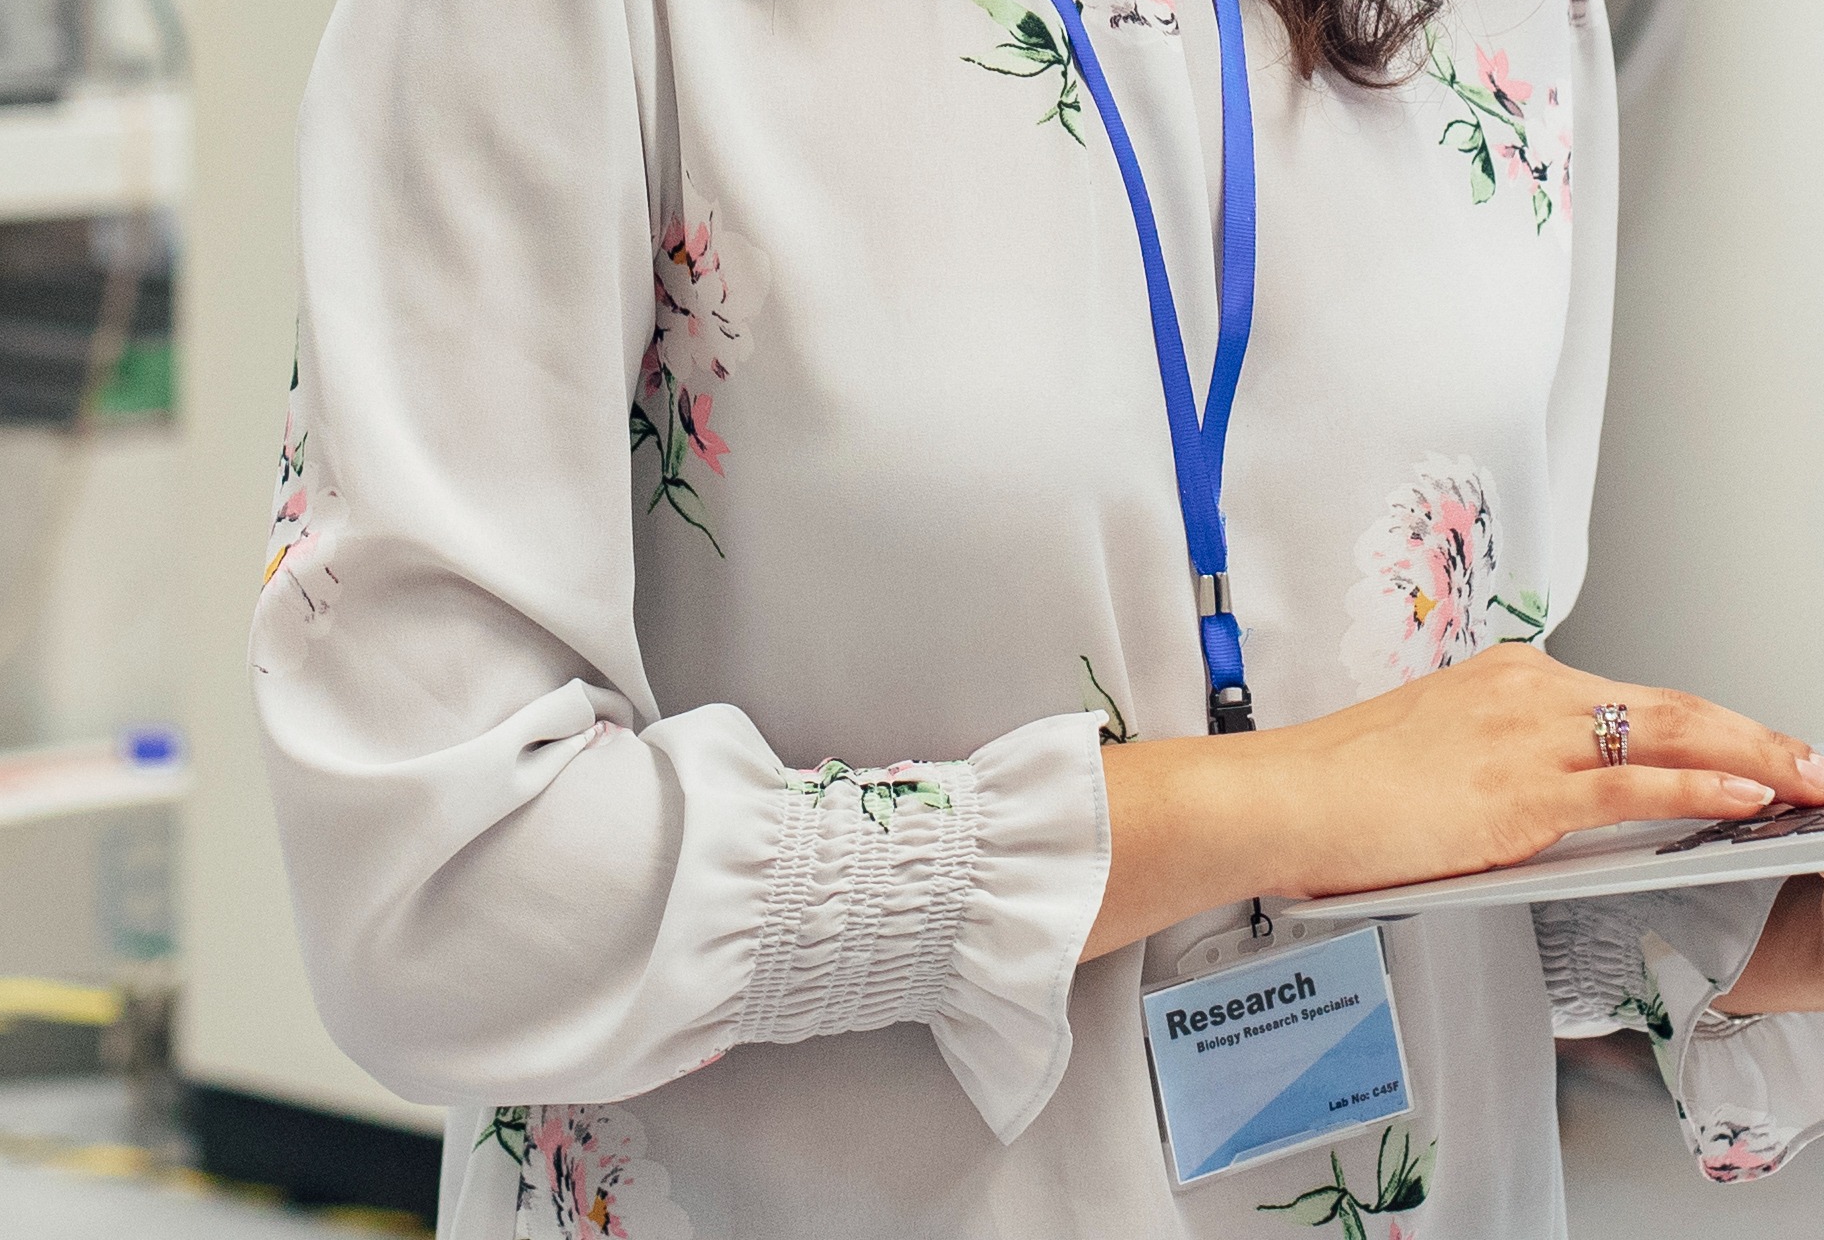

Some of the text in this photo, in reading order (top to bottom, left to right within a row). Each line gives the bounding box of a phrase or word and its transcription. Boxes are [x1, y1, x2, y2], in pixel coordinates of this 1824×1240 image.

[1166, 972, 1316, 1040] Research
[1197, 994, 1360, 1053] Biology Research Specialist
[1328, 1080, 1399, 1112] Lab No: C45F
